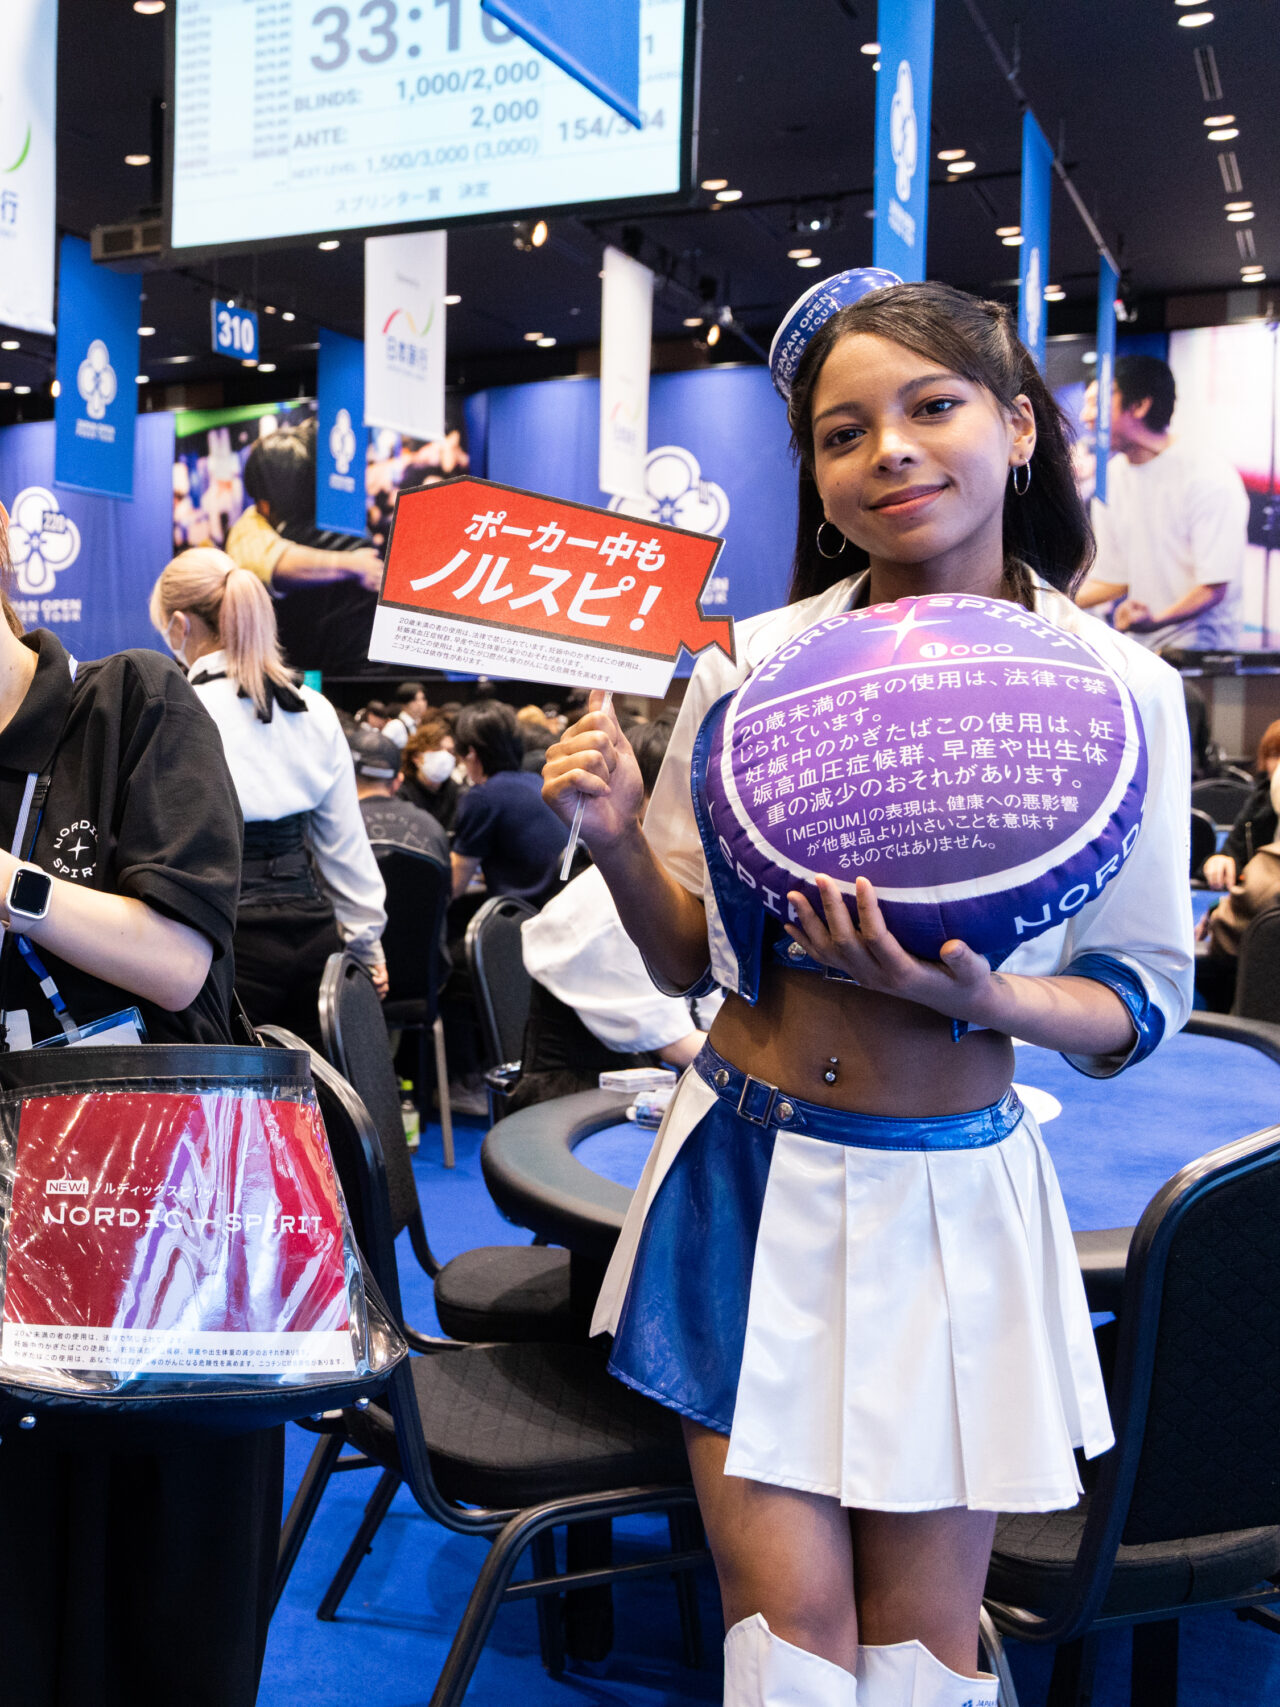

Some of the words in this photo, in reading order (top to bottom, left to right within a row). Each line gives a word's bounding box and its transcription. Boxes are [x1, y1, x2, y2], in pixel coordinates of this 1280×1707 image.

[397, 60, 540, 103] 1,000/2,000
[471, 99, 539, 129] 2,000
[217, 310, 255, 354] 310
[776, 330, 801, 374] JAPAN
[799, 293, 833, 328] OPEN
[784, 338, 807, 378] POKER
[807, 299, 841, 332] TOUR
[43, 512, 66, 532] 220
[464, 510, 665, 572] ポーカー中も
[40, 598, 82, 612] OPEN
[410, 548, 662, 632] ノルスピ！
[43, 611, 82, 624] TOUR
[758, 602, 899, 682] NORDIC
[927, 597, 1077, 650] SPIRIT
[739, 667, 1108, 743] 20歳未満の者の使用は、法律で禁
[740, 707, 882, 764] じられています。
[745, 712, 1115, 786] 妊娠中のかぎたばこの使用は、妊
[752, 737, 1108, 807] 娠高血圧症候群、早産や出生体
[766, 764, 1082, 828] 重の減少のおそれがあります。
[785, 793, 1080, 846] 「MEDIUM」の表現は、健康への悪影響
[807, 813, 1059, 857] が他製品より小さいことを意味す
[53, 857, 97, 879] SPIR
[838, 833, 996, 869] るものではありません。
[1014, 792, 1147, 935] NORD
[48, 1182, 87, 1193] NEW!
[42, 1204, 185, 1230] NORDIC
[223, 1213, 323, 1235] SPIRIT
